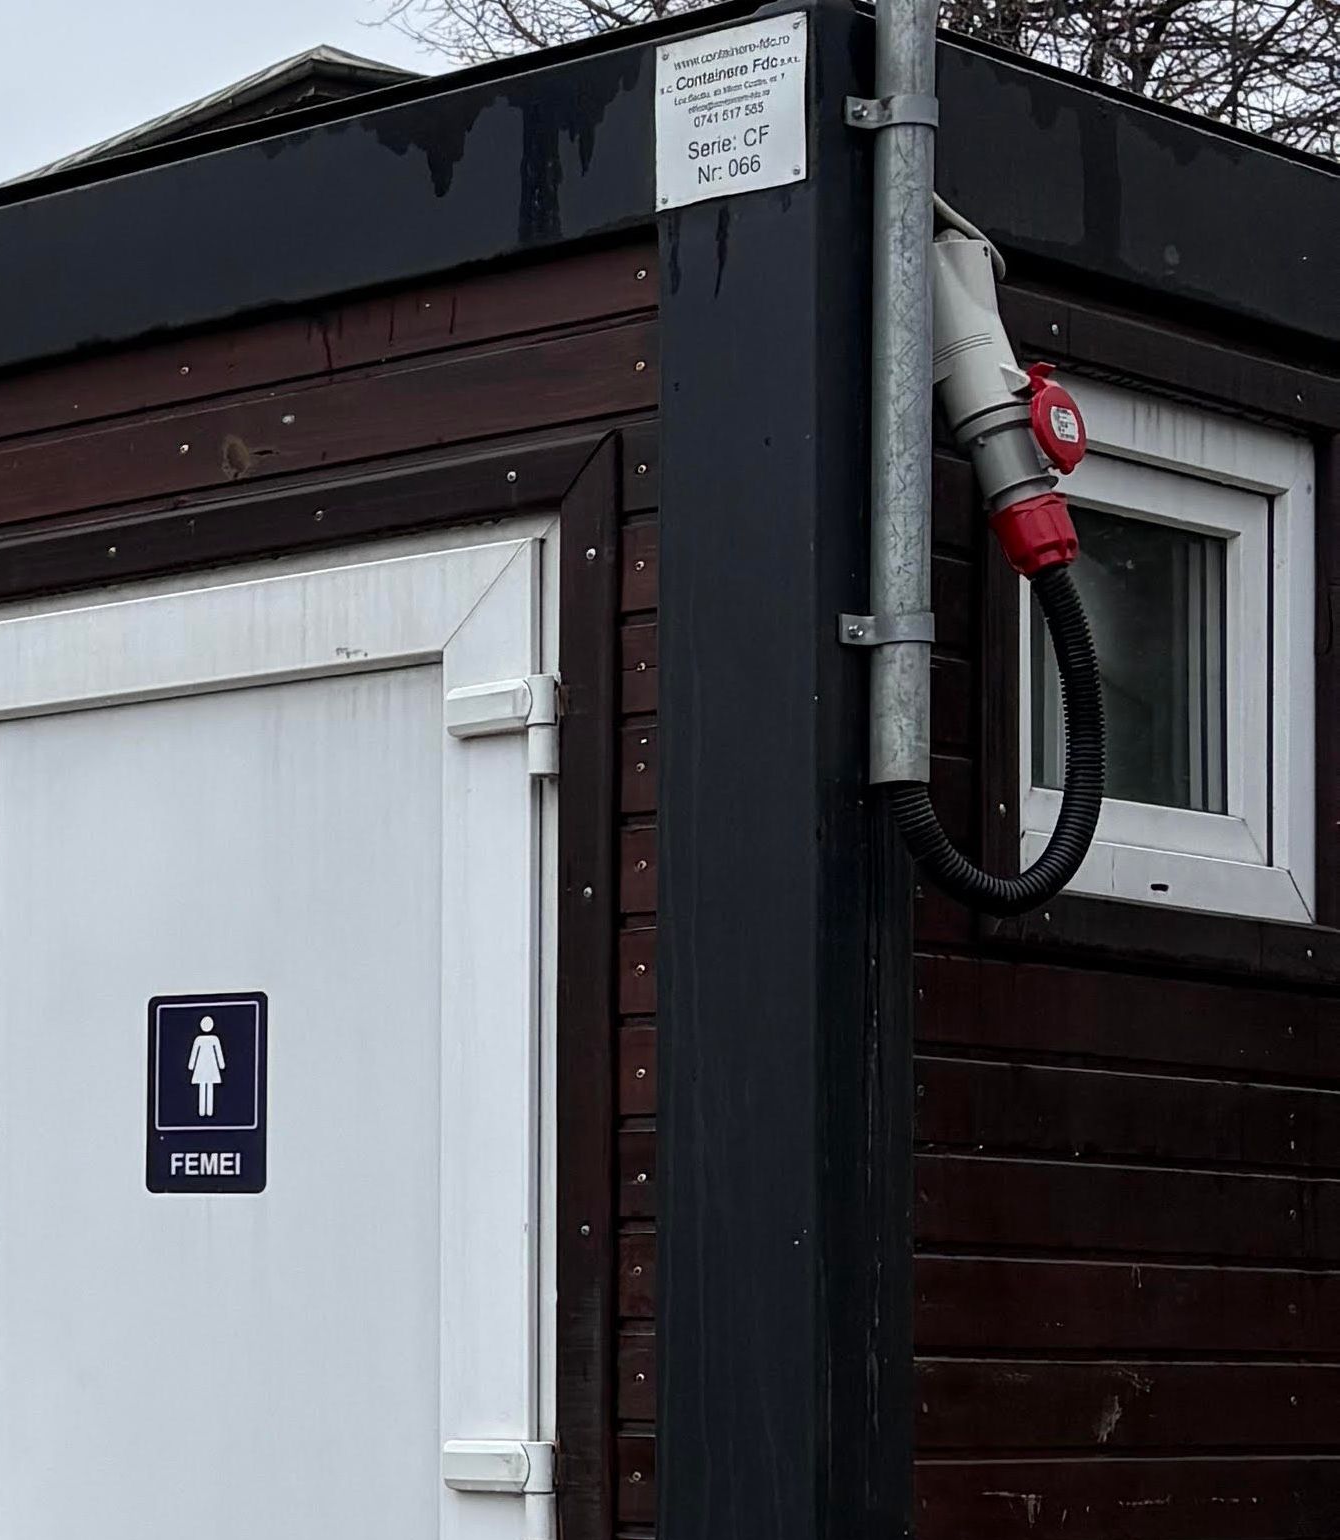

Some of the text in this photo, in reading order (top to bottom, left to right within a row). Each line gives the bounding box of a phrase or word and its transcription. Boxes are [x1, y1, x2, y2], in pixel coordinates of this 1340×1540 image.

[694, 112, 718, 128] 0741
[688, 124, 770, 160] Serie: CF
[698, 154, 761, 184] Nr. 066
[170, 1152, 241, 1176] FEMEI
